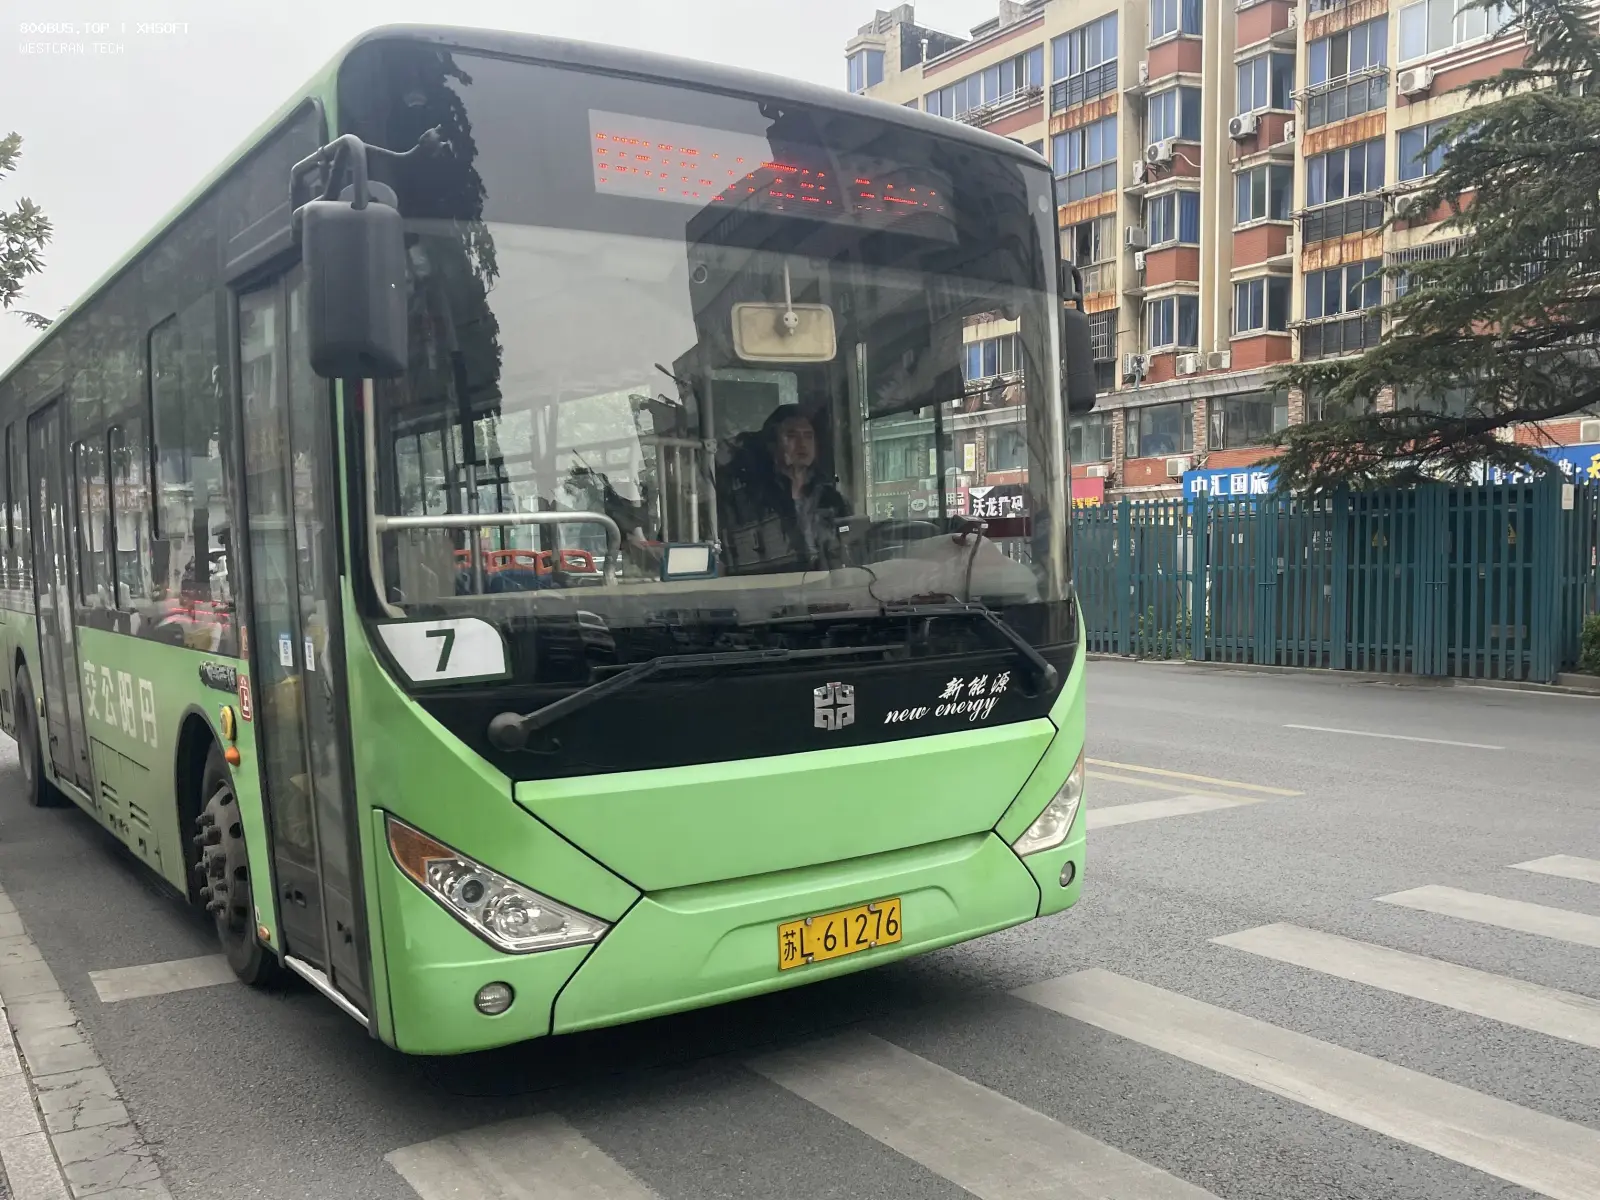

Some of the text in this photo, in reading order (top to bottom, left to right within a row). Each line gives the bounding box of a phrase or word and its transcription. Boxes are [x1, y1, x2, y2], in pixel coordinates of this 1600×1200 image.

[425, 628, 456, 672] 7
[938, 670, 1011, 700] 新能源
[884, 694, 1001, 724] new energy
